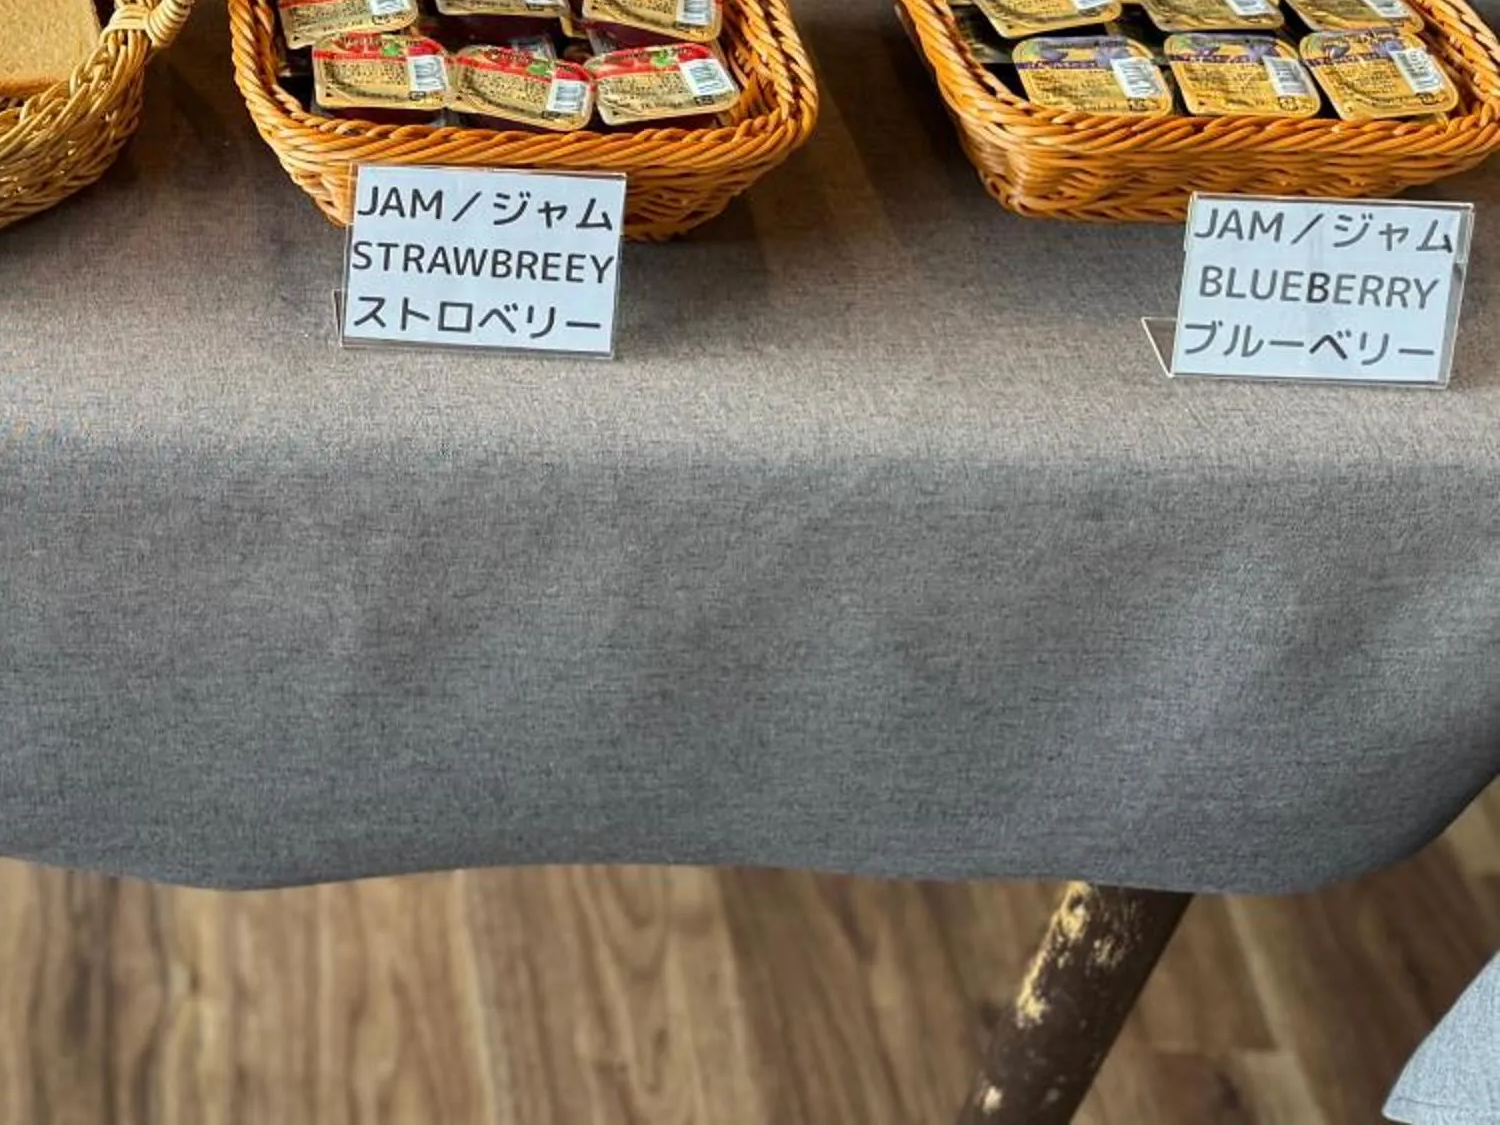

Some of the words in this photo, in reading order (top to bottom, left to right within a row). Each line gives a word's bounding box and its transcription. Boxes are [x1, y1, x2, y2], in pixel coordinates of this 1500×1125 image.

[352, 241, 614, 284] STRAWBREEY
[1199, 265, 1440, 310] BLUEBERRY
[354, 295, 601, 339] ストロベリー
[1184, 320, 1435, 366] ブルーベリー
